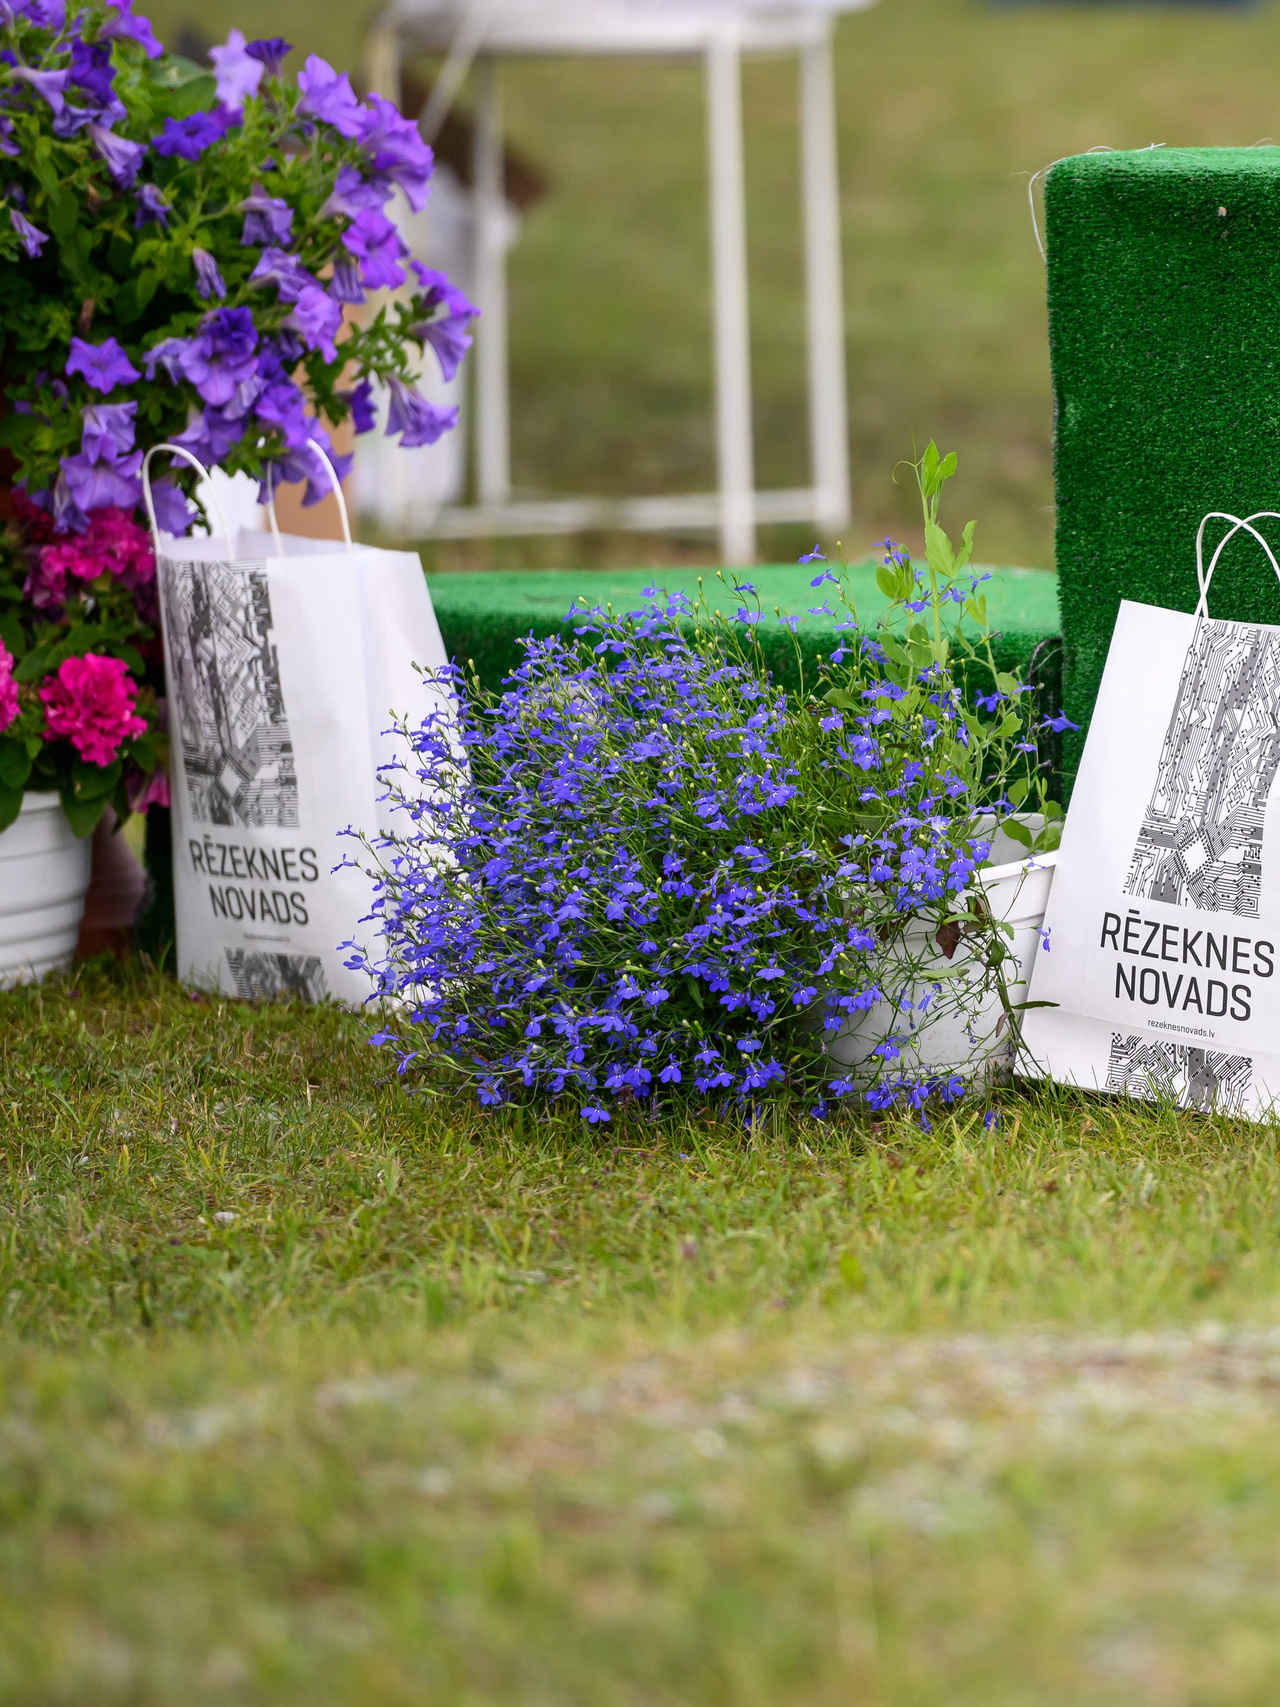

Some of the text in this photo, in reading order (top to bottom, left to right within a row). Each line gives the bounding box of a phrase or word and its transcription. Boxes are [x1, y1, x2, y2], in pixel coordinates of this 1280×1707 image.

[189, 834, 319, 882] RĒZEKNES
[209, 884, 309, 926] NOVADS
[1100, 909, 1275, 978] RĒZEKNES
[1115, 962, 1252, 1022] NOVADS
[1147, 1020, 1216, 1038] rezeknesnovads.lv
